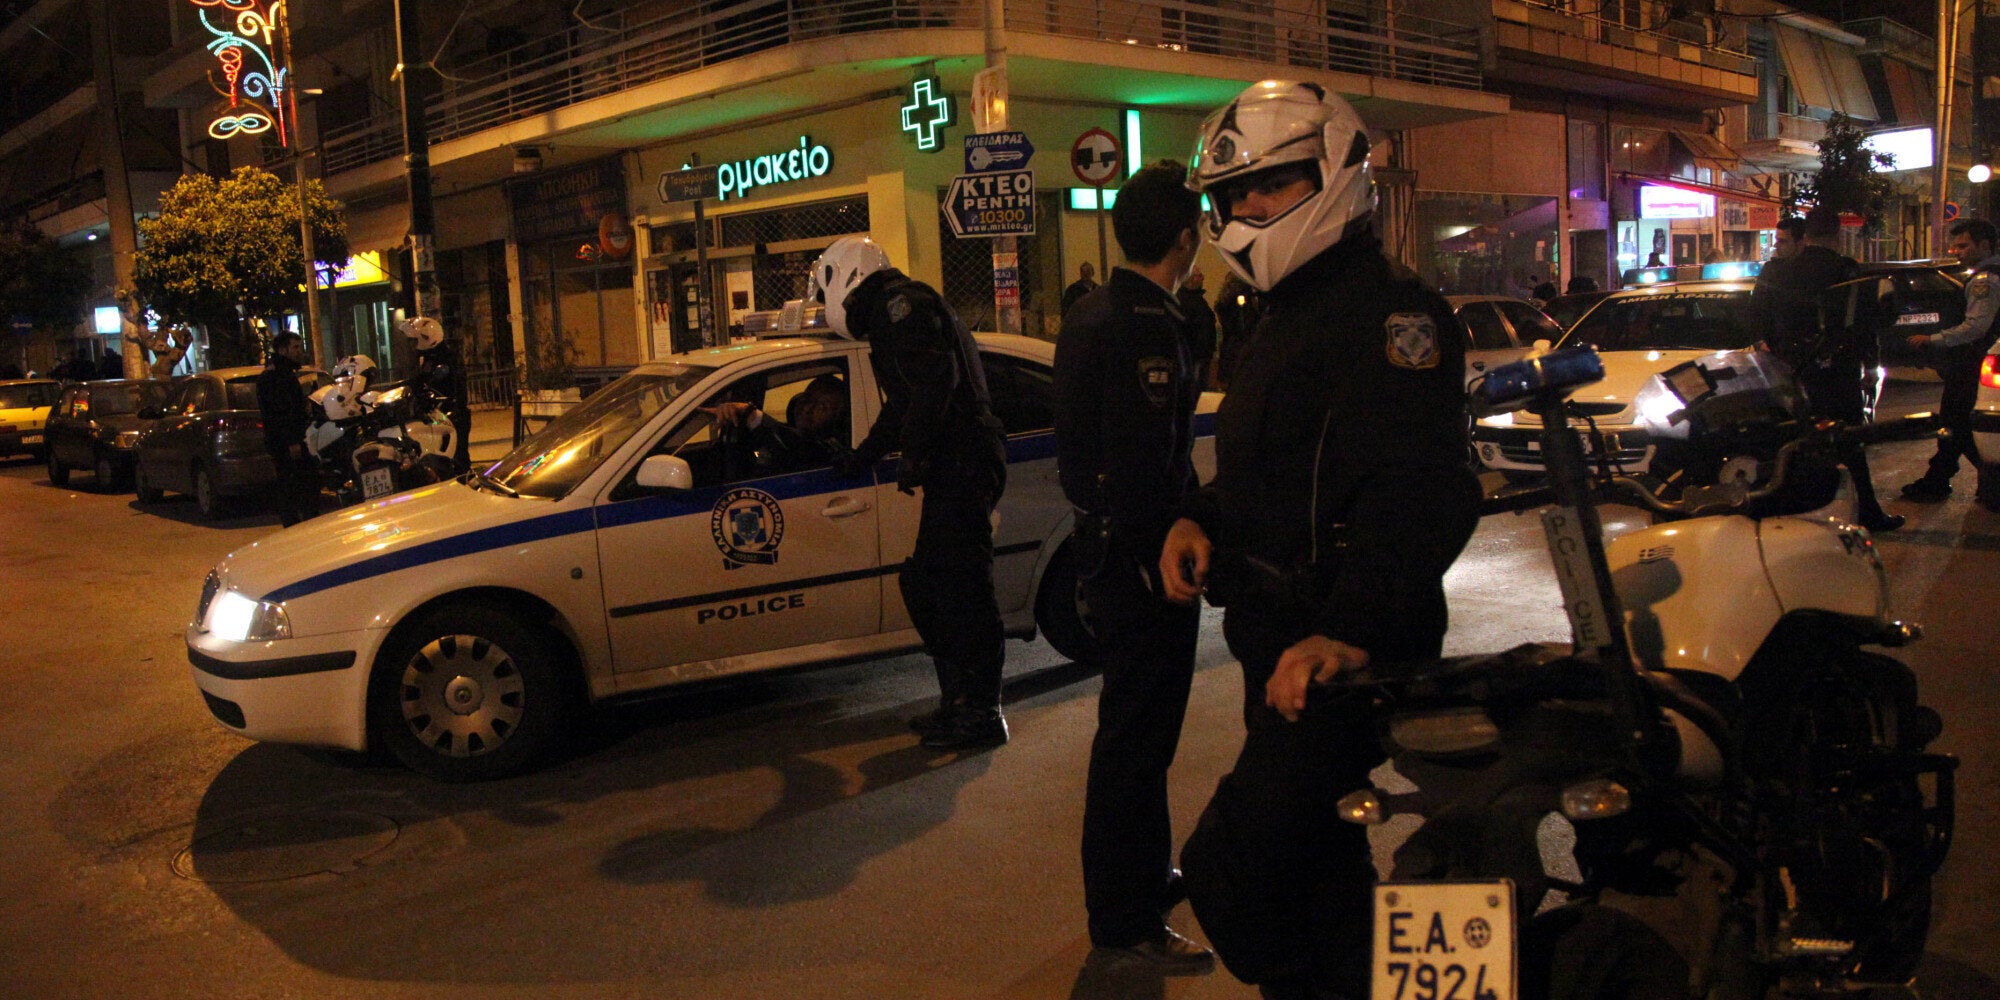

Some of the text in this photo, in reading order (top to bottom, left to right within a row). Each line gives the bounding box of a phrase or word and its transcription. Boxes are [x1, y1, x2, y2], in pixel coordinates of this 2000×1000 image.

[966, 133, 1024, 148] ΚΛΕΙΔΑΡΑΣ
[962, 173, 1031, 197] ΚΤΕΟ
[963, 195, 1031, 211] ΡΕΝΤΗ
[980, 209, 1026, 224] 10300
[1551, 514, 1597, 642] POLICE
[697, 593, 806, 625] POLICE
[1387, 962, 1499, 1000] 7924
